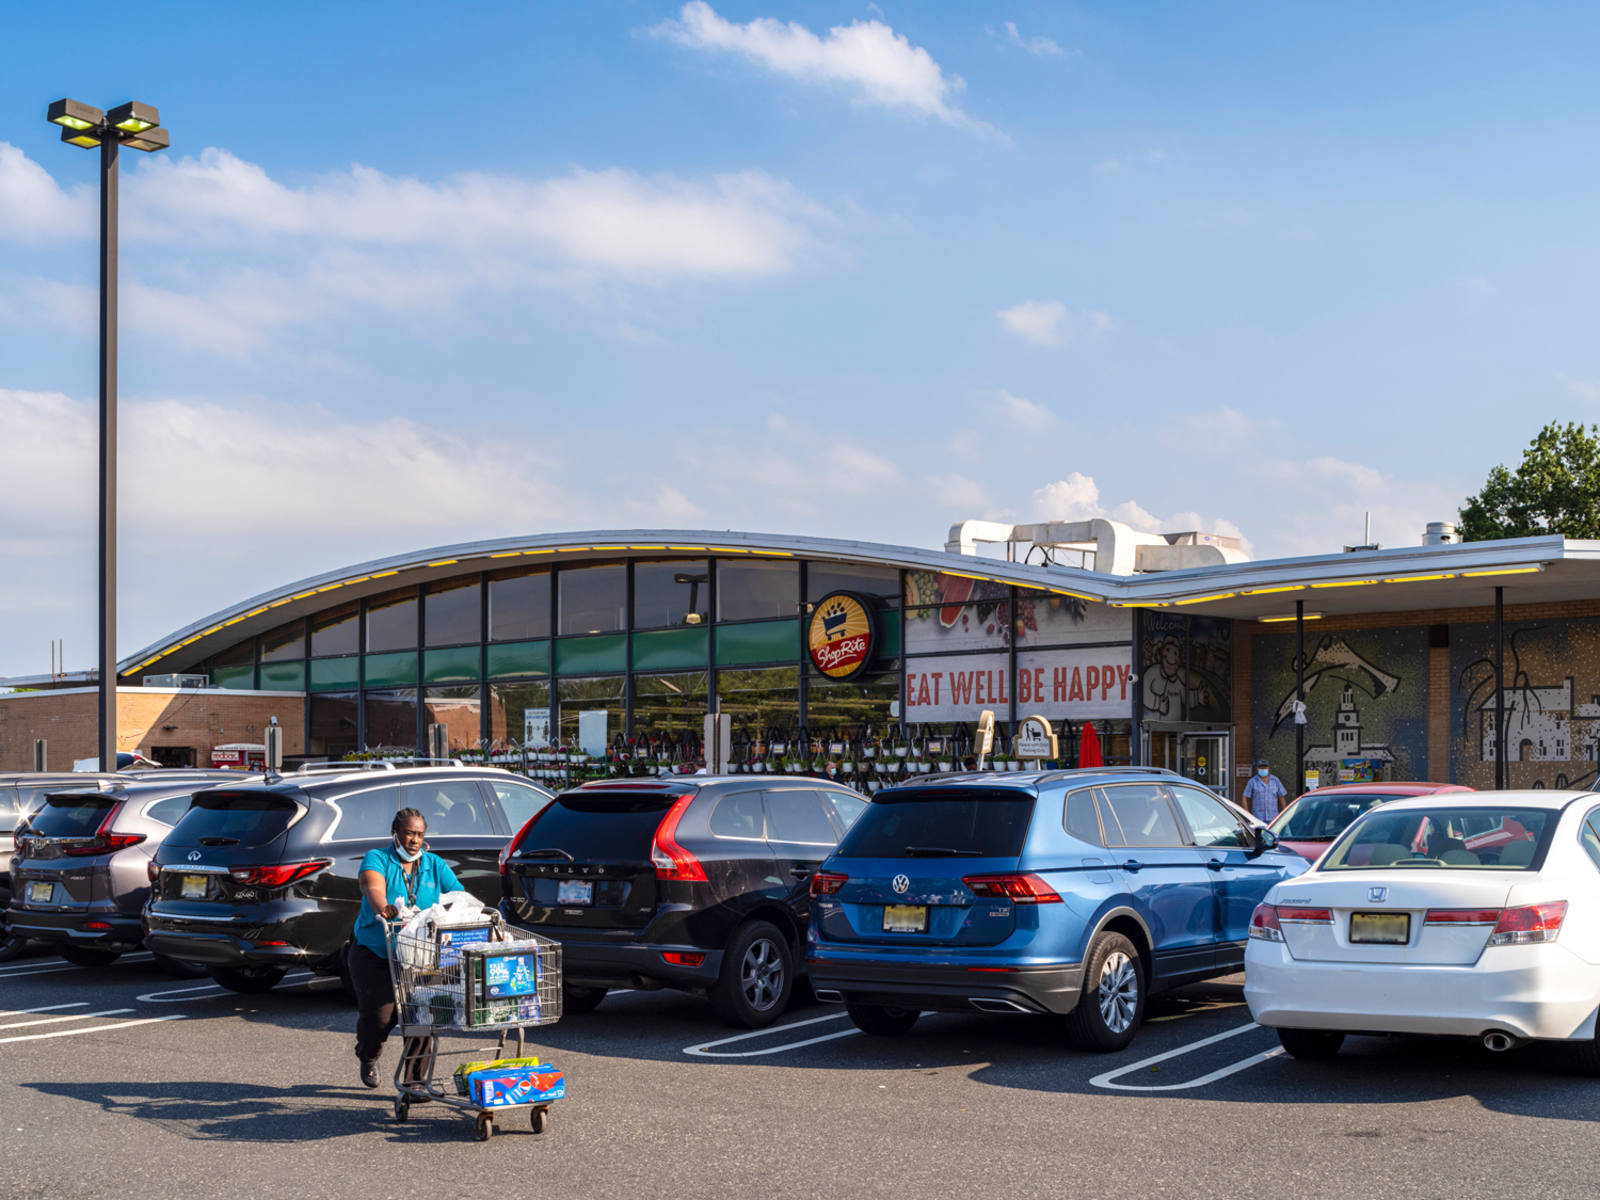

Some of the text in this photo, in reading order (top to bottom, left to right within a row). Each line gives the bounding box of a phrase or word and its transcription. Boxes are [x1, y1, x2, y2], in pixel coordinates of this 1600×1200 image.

[906, 664, 1131, 706] EAT WELL BE HAPPY
